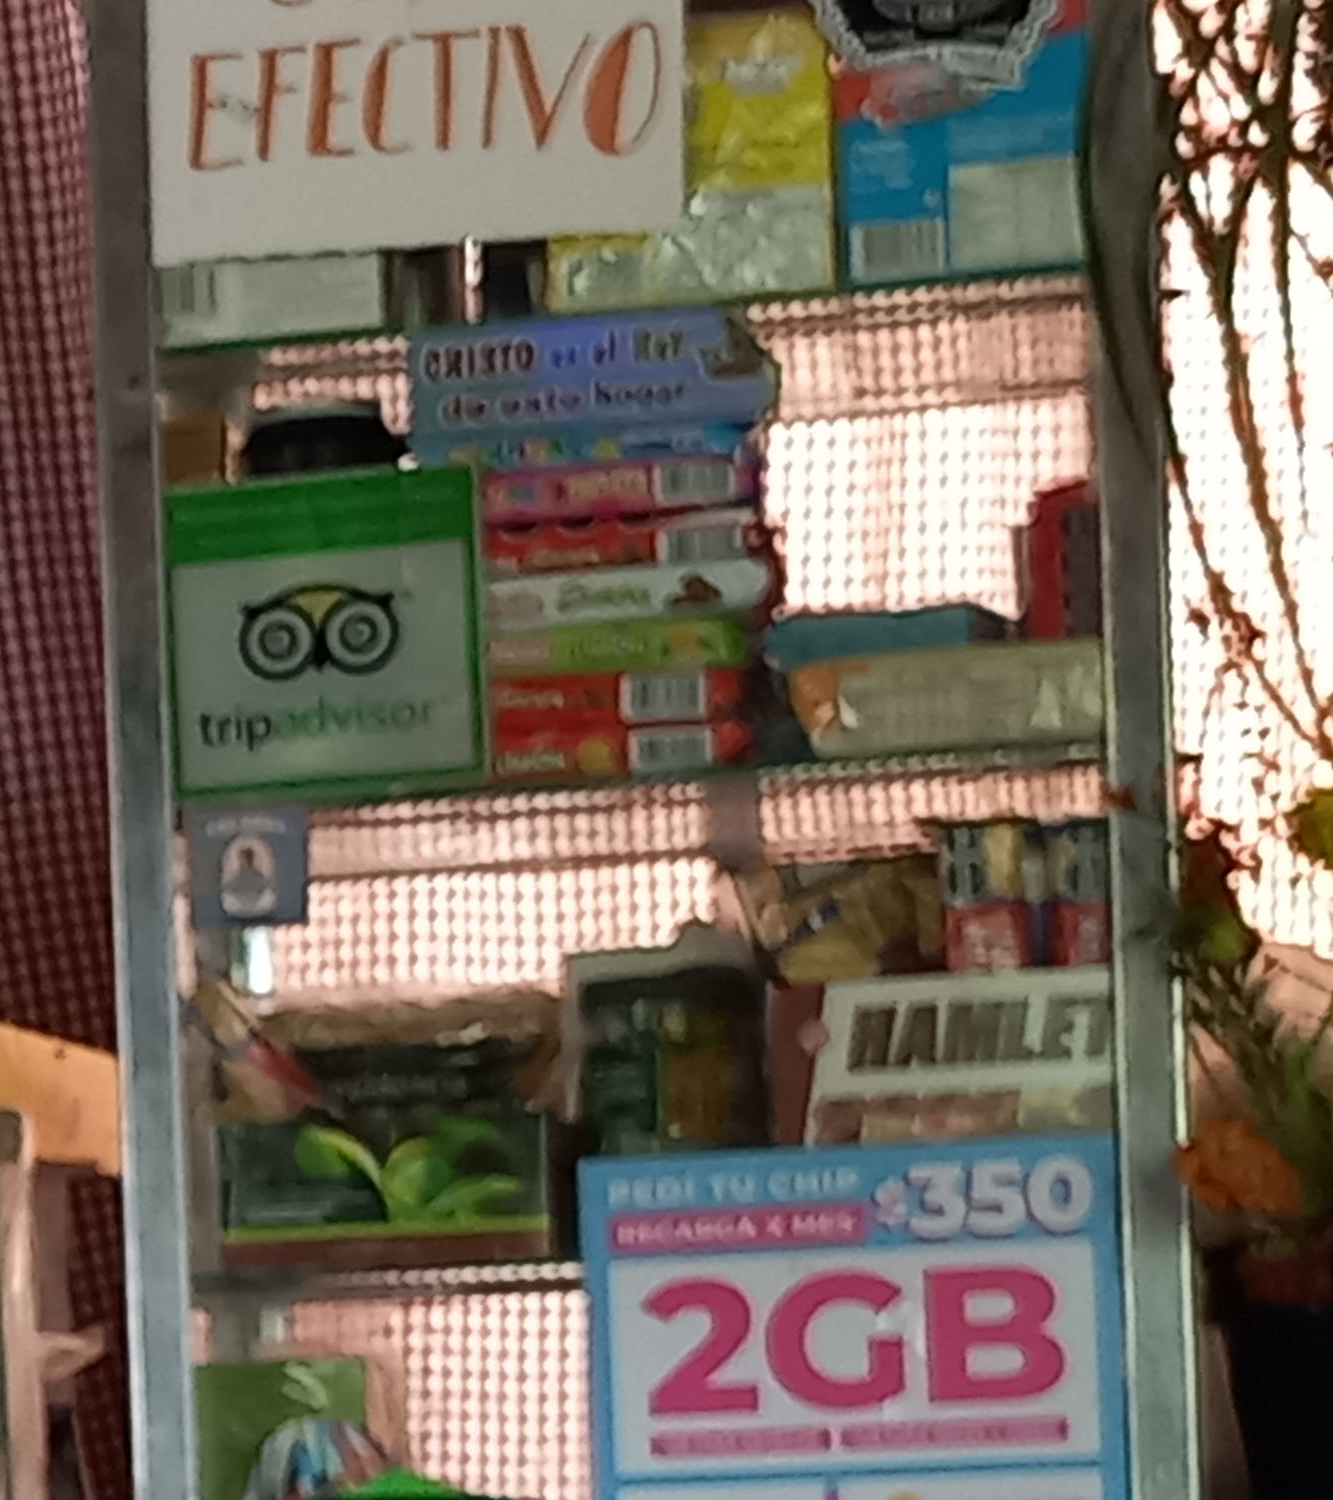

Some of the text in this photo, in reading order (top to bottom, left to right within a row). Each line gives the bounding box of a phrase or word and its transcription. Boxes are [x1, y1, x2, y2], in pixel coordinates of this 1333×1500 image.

[189, 19, 661, 171] EFECTIVO
[198, 693, 433, 752] tripadvisor
[614, 1213, 758, 1247] RECARGA
[767, 1165, 861, 1201] CHIP
[873, 1154, 1095, 1242] $350
[639, 1263, 1068, 1417] 2GB
